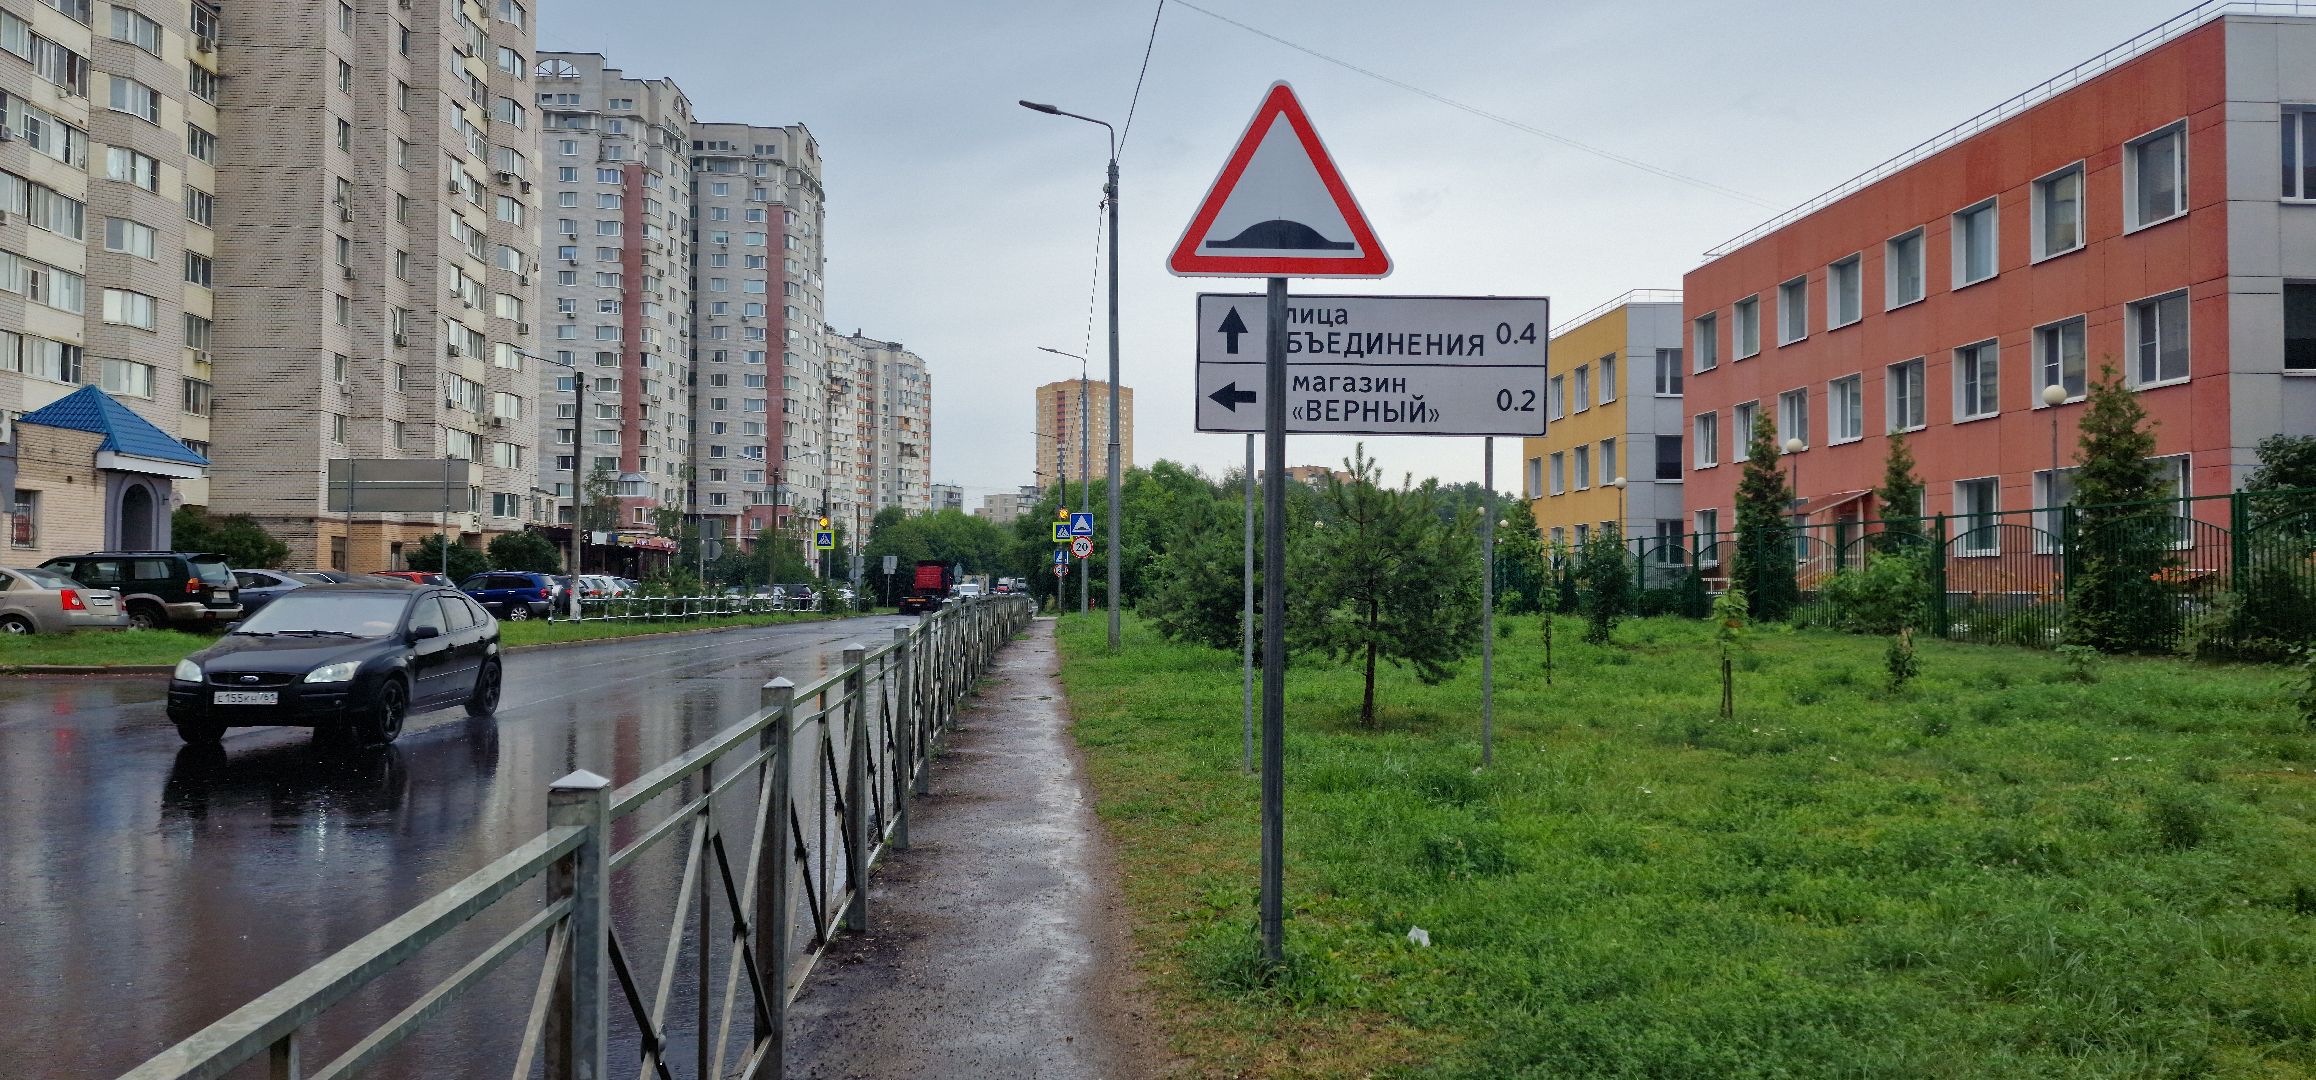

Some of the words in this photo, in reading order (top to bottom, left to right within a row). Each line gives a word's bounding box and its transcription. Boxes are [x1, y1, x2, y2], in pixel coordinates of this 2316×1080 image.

[1287, 307, 1348, 327] лица
[1287, 331, 1484, 358] БЪЕДИНЕНИЯ
[1496, 322, 1537, 345] 0.4
[1292, 375, 1406, 393] магазин
[1292, 394, 1440, 423] «ВЕРНЫЙ»
[1496, 388, 1536, 412] 0.2
[1076, 542, 1088, 551] 20
